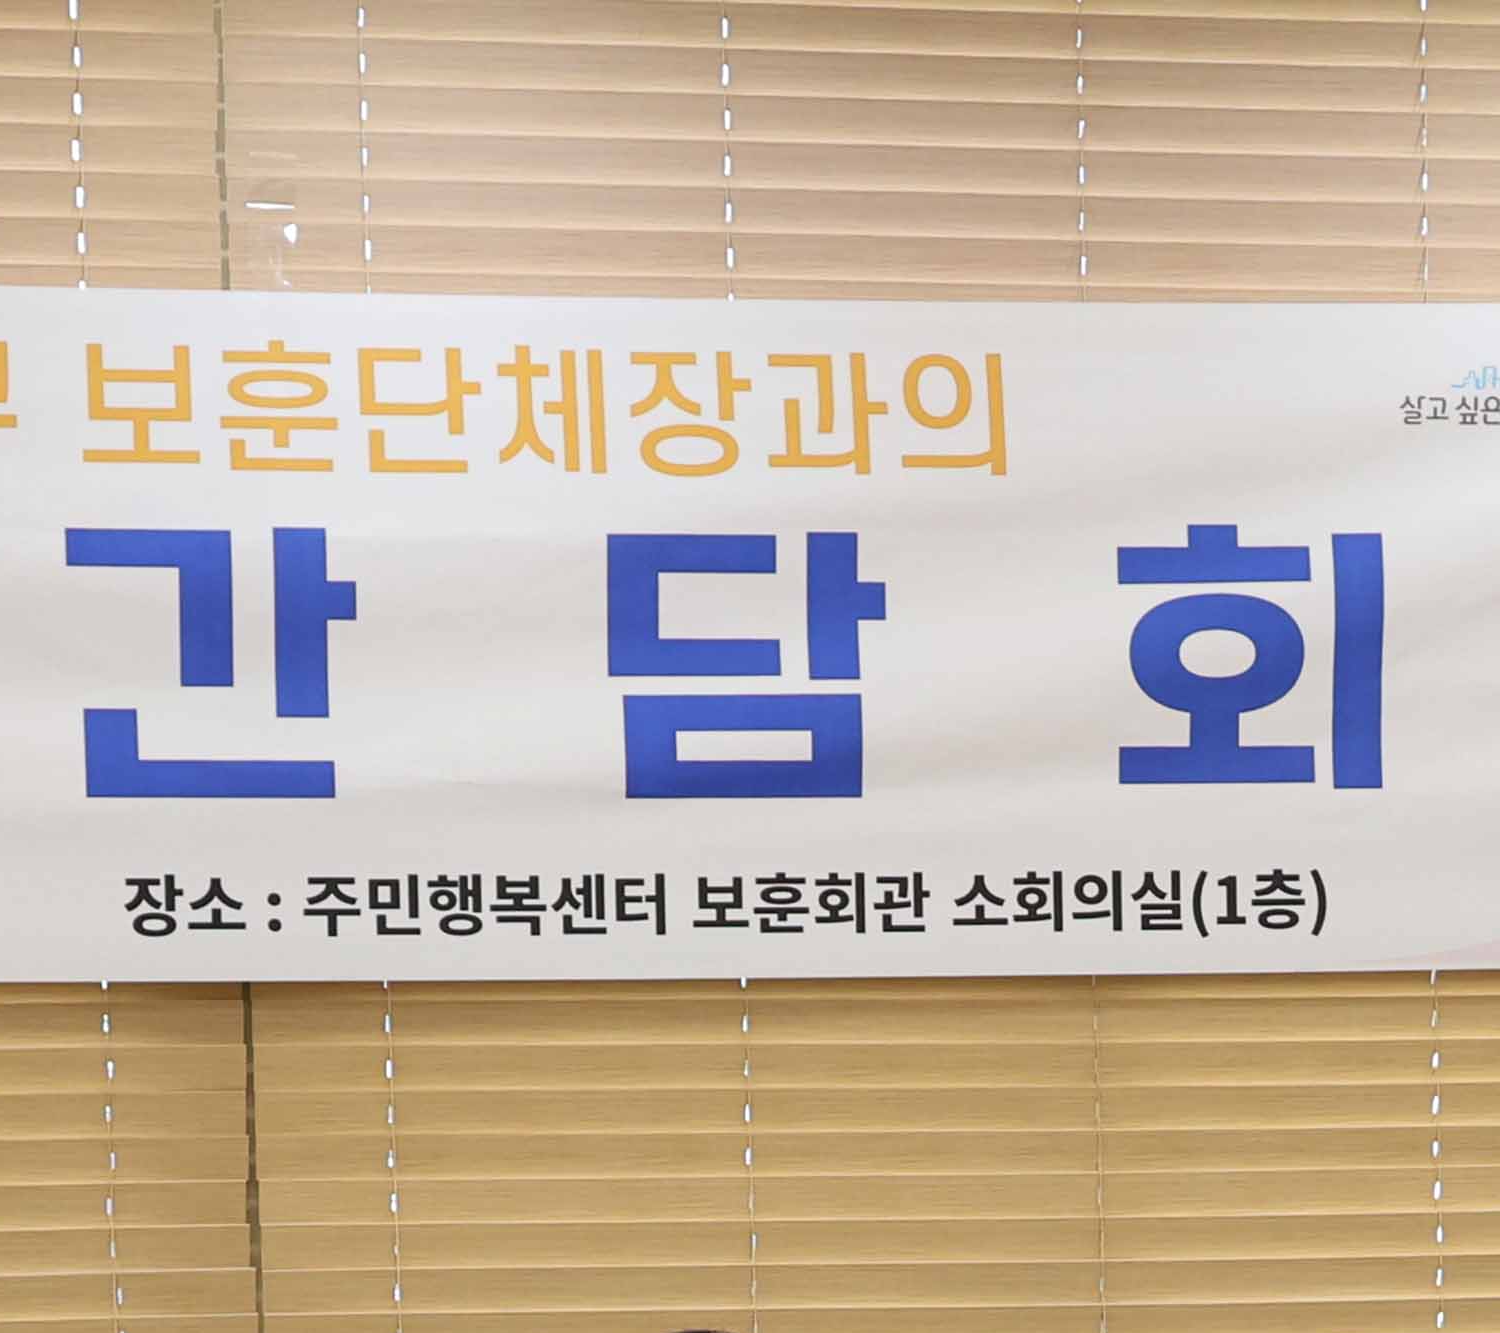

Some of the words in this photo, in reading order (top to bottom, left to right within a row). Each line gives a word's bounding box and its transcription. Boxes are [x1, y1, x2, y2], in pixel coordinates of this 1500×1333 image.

[82, 340, 1008, 478] 보훈단체장과의
[1400, 395, 1449, 425] 살고
[65, 527, 358, 799] 간
[606, 531, 887, 800] 담
[1117, 524, 1385, 790] 회
[124, 873, 248, 938] 장소
[302, 872, 667, 938] 주민행복센터
[692, 870, 931, 935] 보훈회관
[952, 868, 1328, 939] 소회의실(1층)
